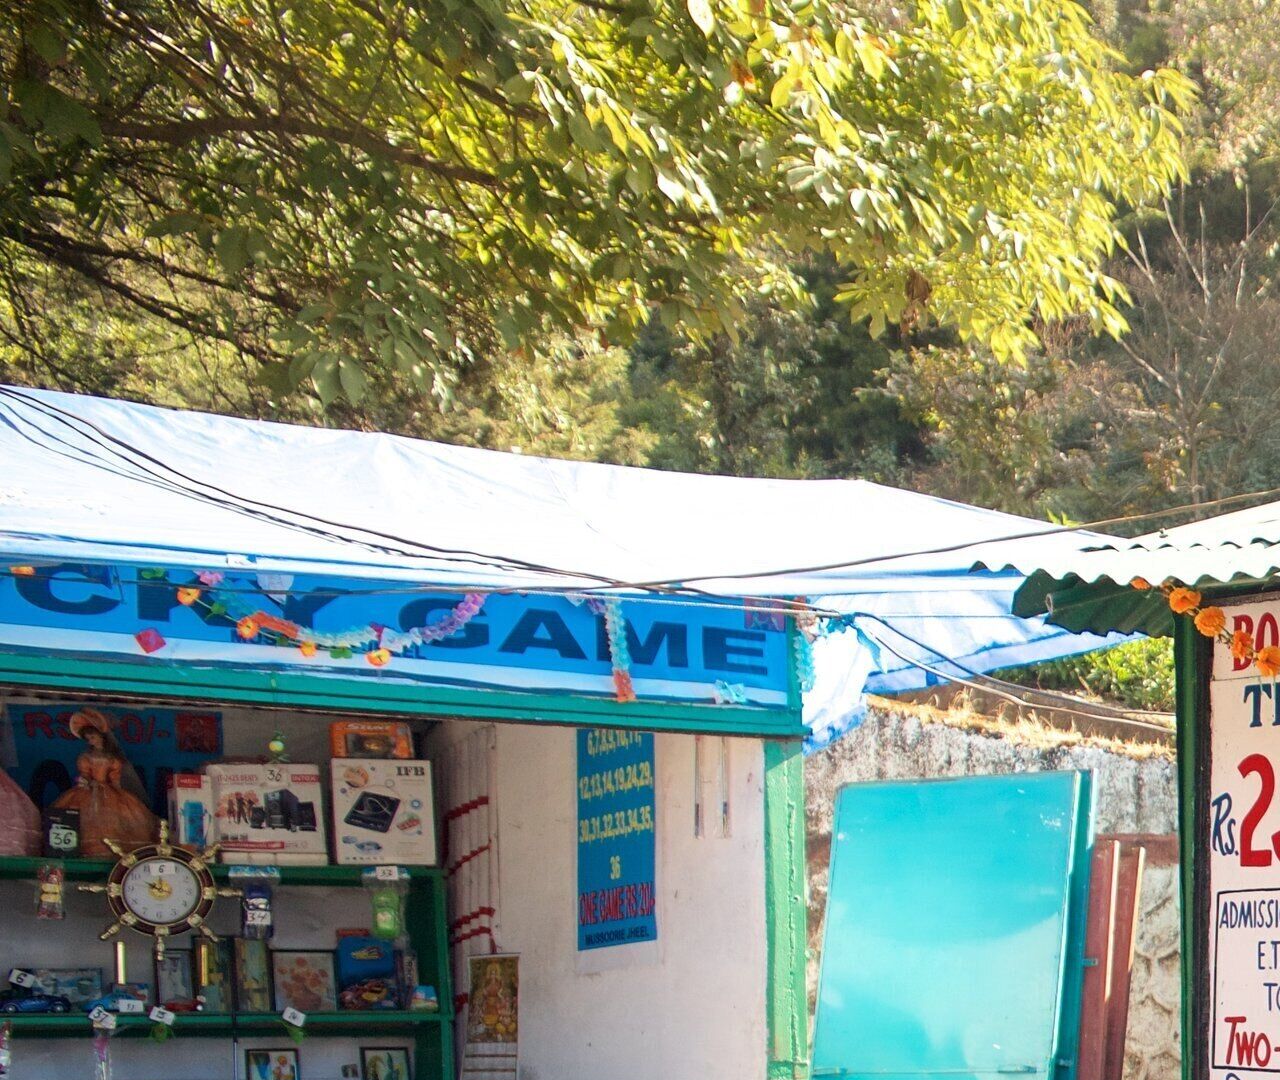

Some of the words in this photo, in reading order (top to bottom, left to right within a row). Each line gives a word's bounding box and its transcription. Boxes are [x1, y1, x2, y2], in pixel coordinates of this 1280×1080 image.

[398, 596, 768, 676] GAME
[267, 769, 283, 781] 36
[396, 766, 425, 776] IFB
[52, 832, 72, 845] 36
[610, 855, 621, 880] 36
[599, 886, 625, 924] GAME
